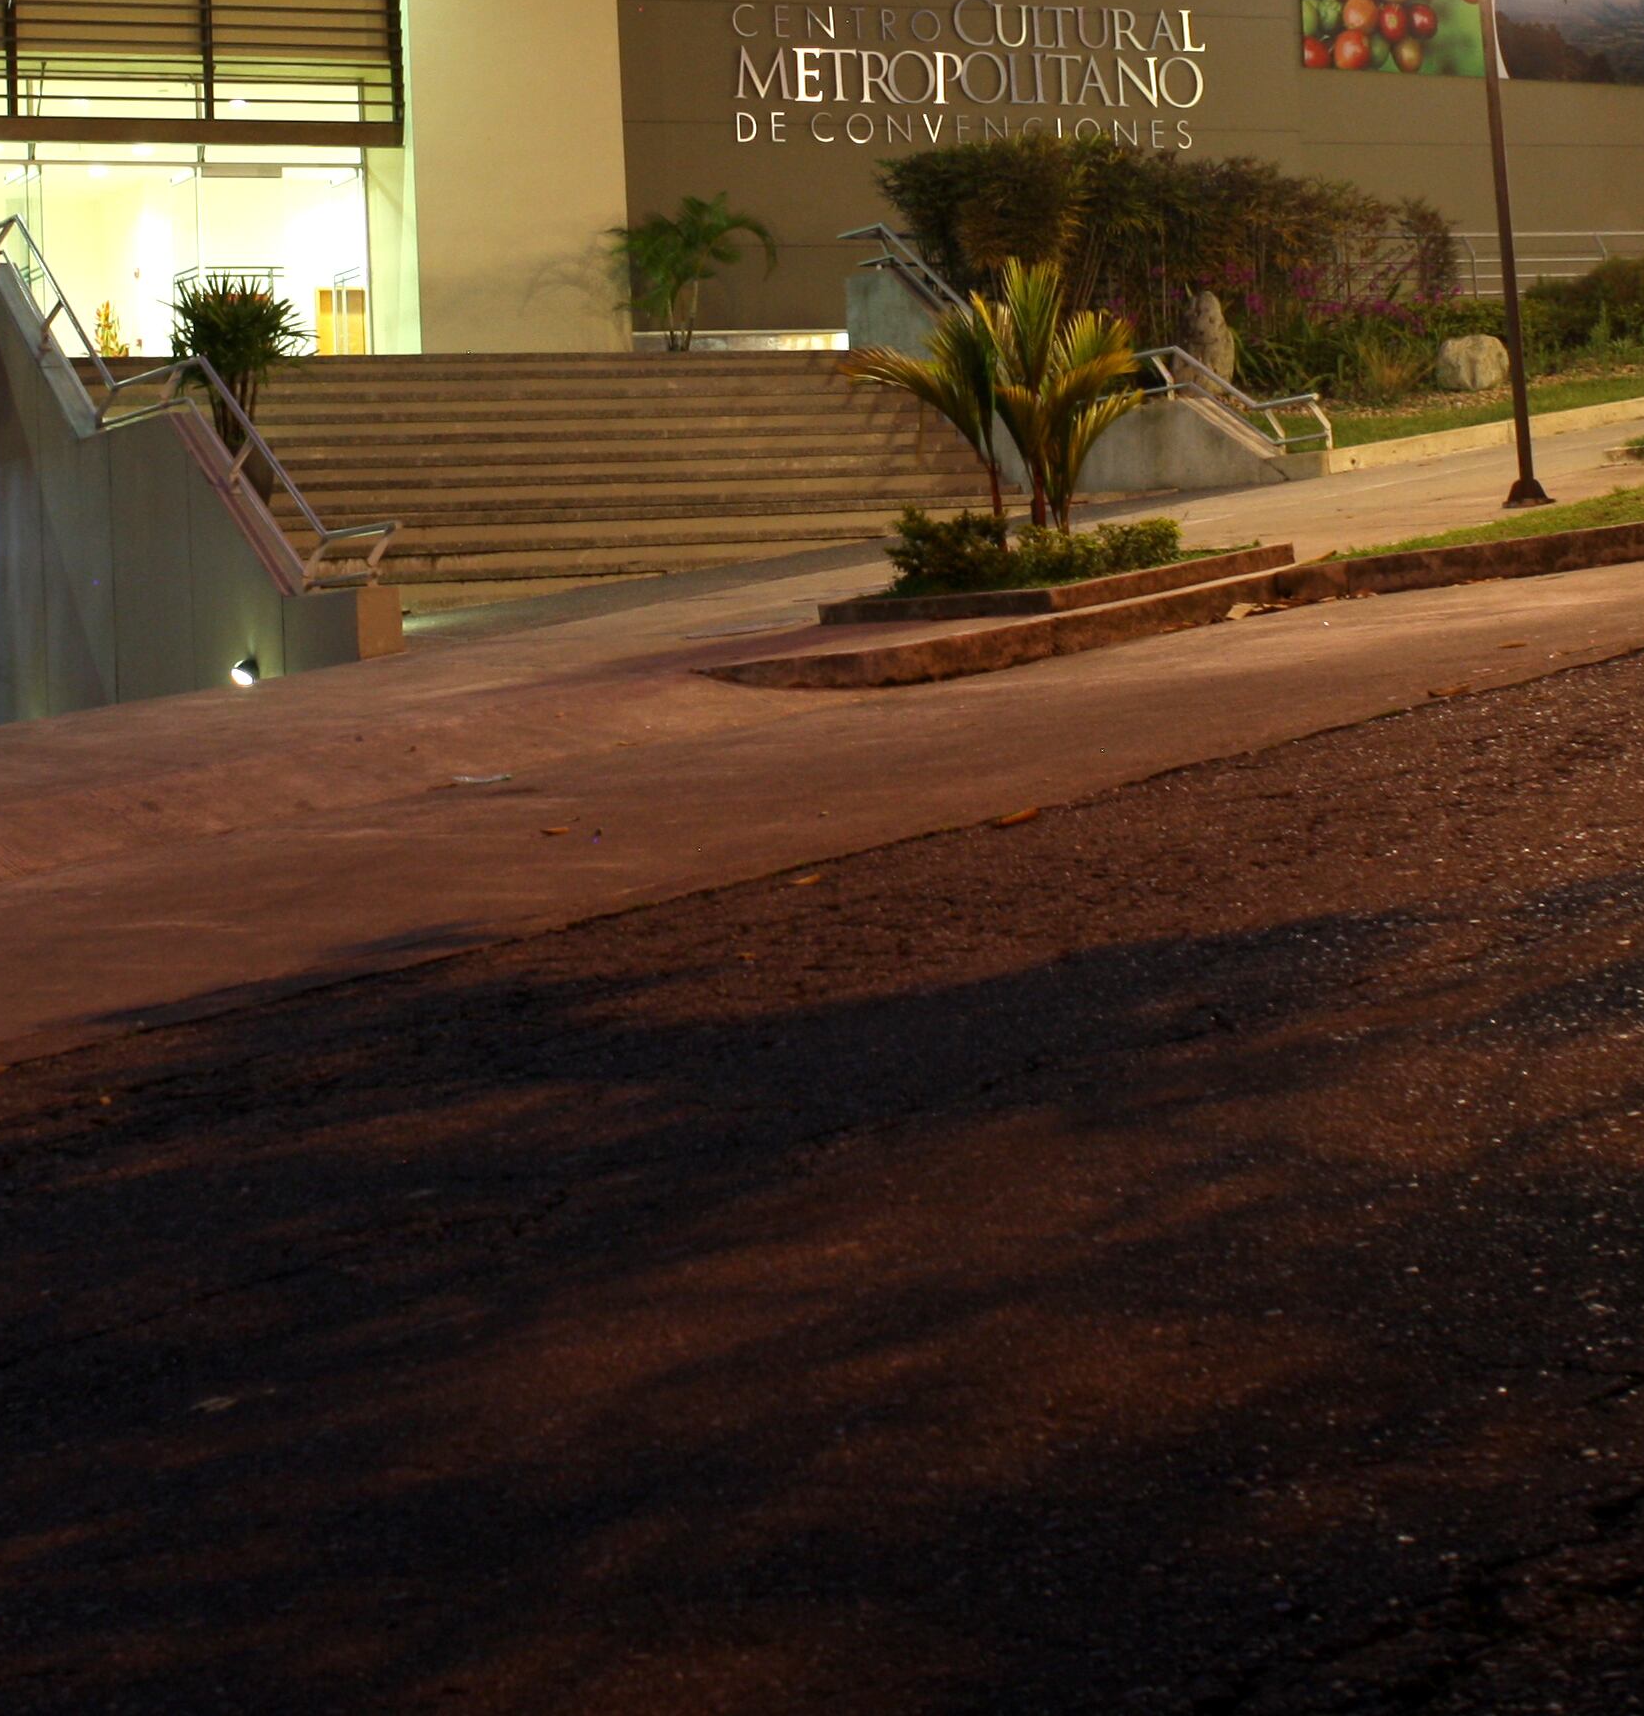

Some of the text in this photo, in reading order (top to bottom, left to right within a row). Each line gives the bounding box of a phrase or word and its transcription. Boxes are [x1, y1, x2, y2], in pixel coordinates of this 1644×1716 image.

[732, 3, 942, 42] CENTRO
[734, 44, 1204, 109] METROPOLITANO
[735, 111, 1194, 150] DE CONVENCIONES
